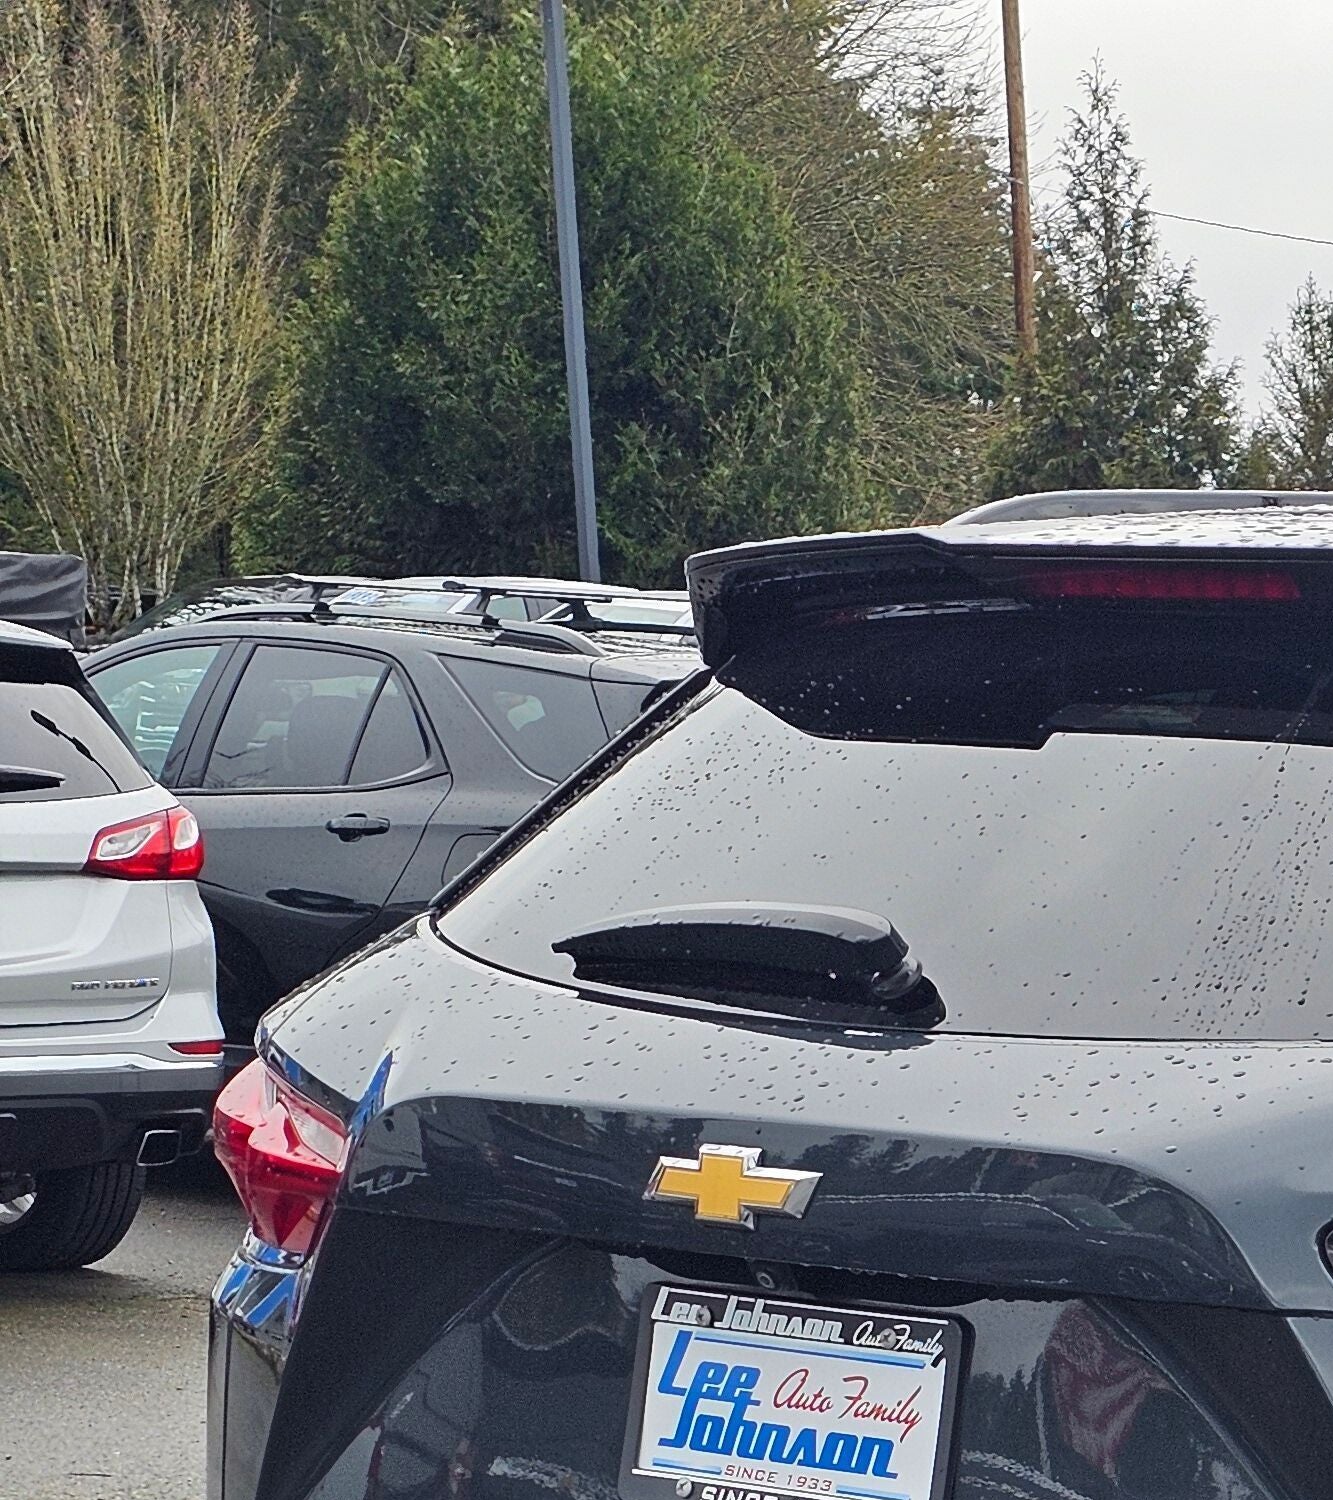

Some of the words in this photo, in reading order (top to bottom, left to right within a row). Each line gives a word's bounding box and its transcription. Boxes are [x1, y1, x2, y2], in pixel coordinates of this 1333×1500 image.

[714, 1295, 845, 1343] Johnson
[852, 1320, 895, 1348] Au
[893, 1323, 944, 1367] Family
[658, 1329, 761, 1404] Lee
[773, 1368, 834, 1412] Auto
[838, 1376, 922, 1443] Family
[658, 1391, 898, 1480] Johnson
[724, 1465, 777, 1483] SINCE
[786, 1475, 833, 1491] 1933
